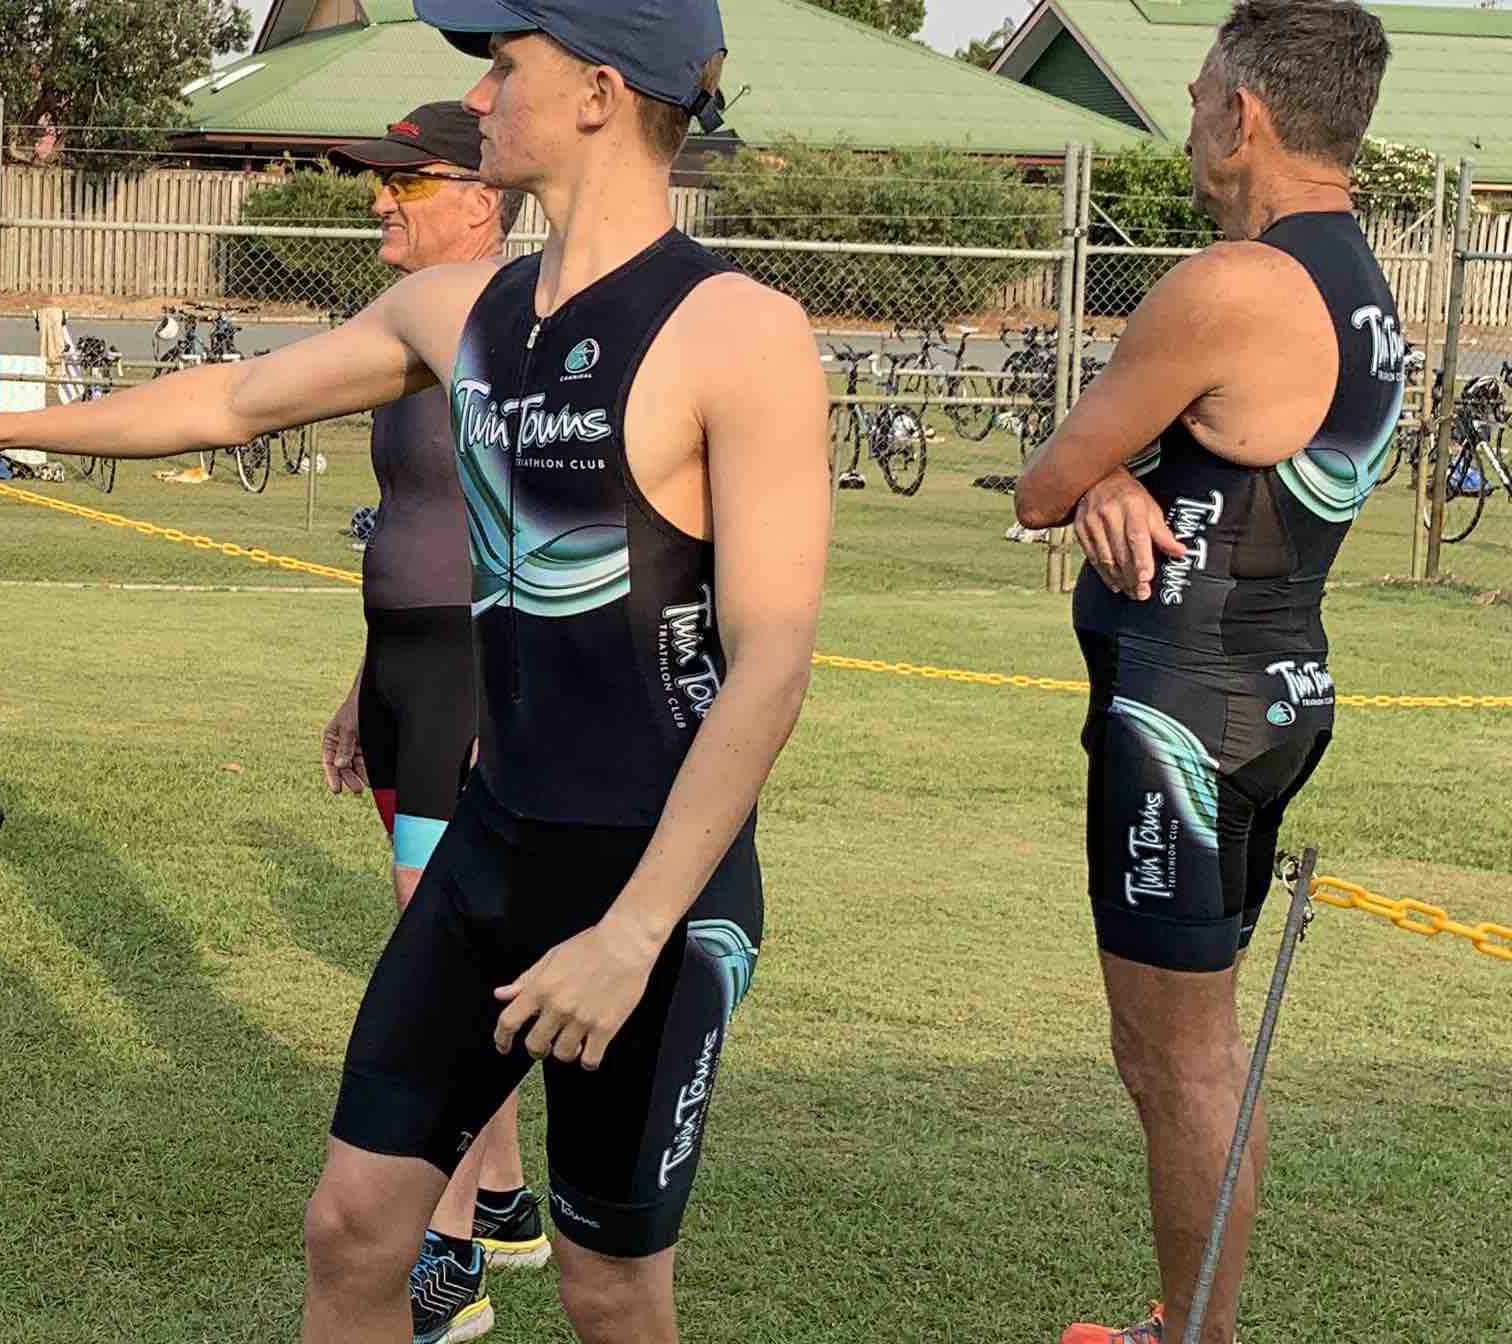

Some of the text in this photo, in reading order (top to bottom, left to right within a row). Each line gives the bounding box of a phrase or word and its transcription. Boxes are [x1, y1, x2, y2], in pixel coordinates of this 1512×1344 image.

[456, 379, 612, 457] Twin Towns
[569, 459, 606, 470] CLUB
[1175, 489, 1224, 540] Twin
[662, 583, 712, 666] Twin
[658, 623, 687, 729] TRIATHLON CLUB
[1124, 791, 1174, 905] Twin Towns
[673, 1027, 720, 1127] Towns
[657, 1109, 700, 1190] Twin
